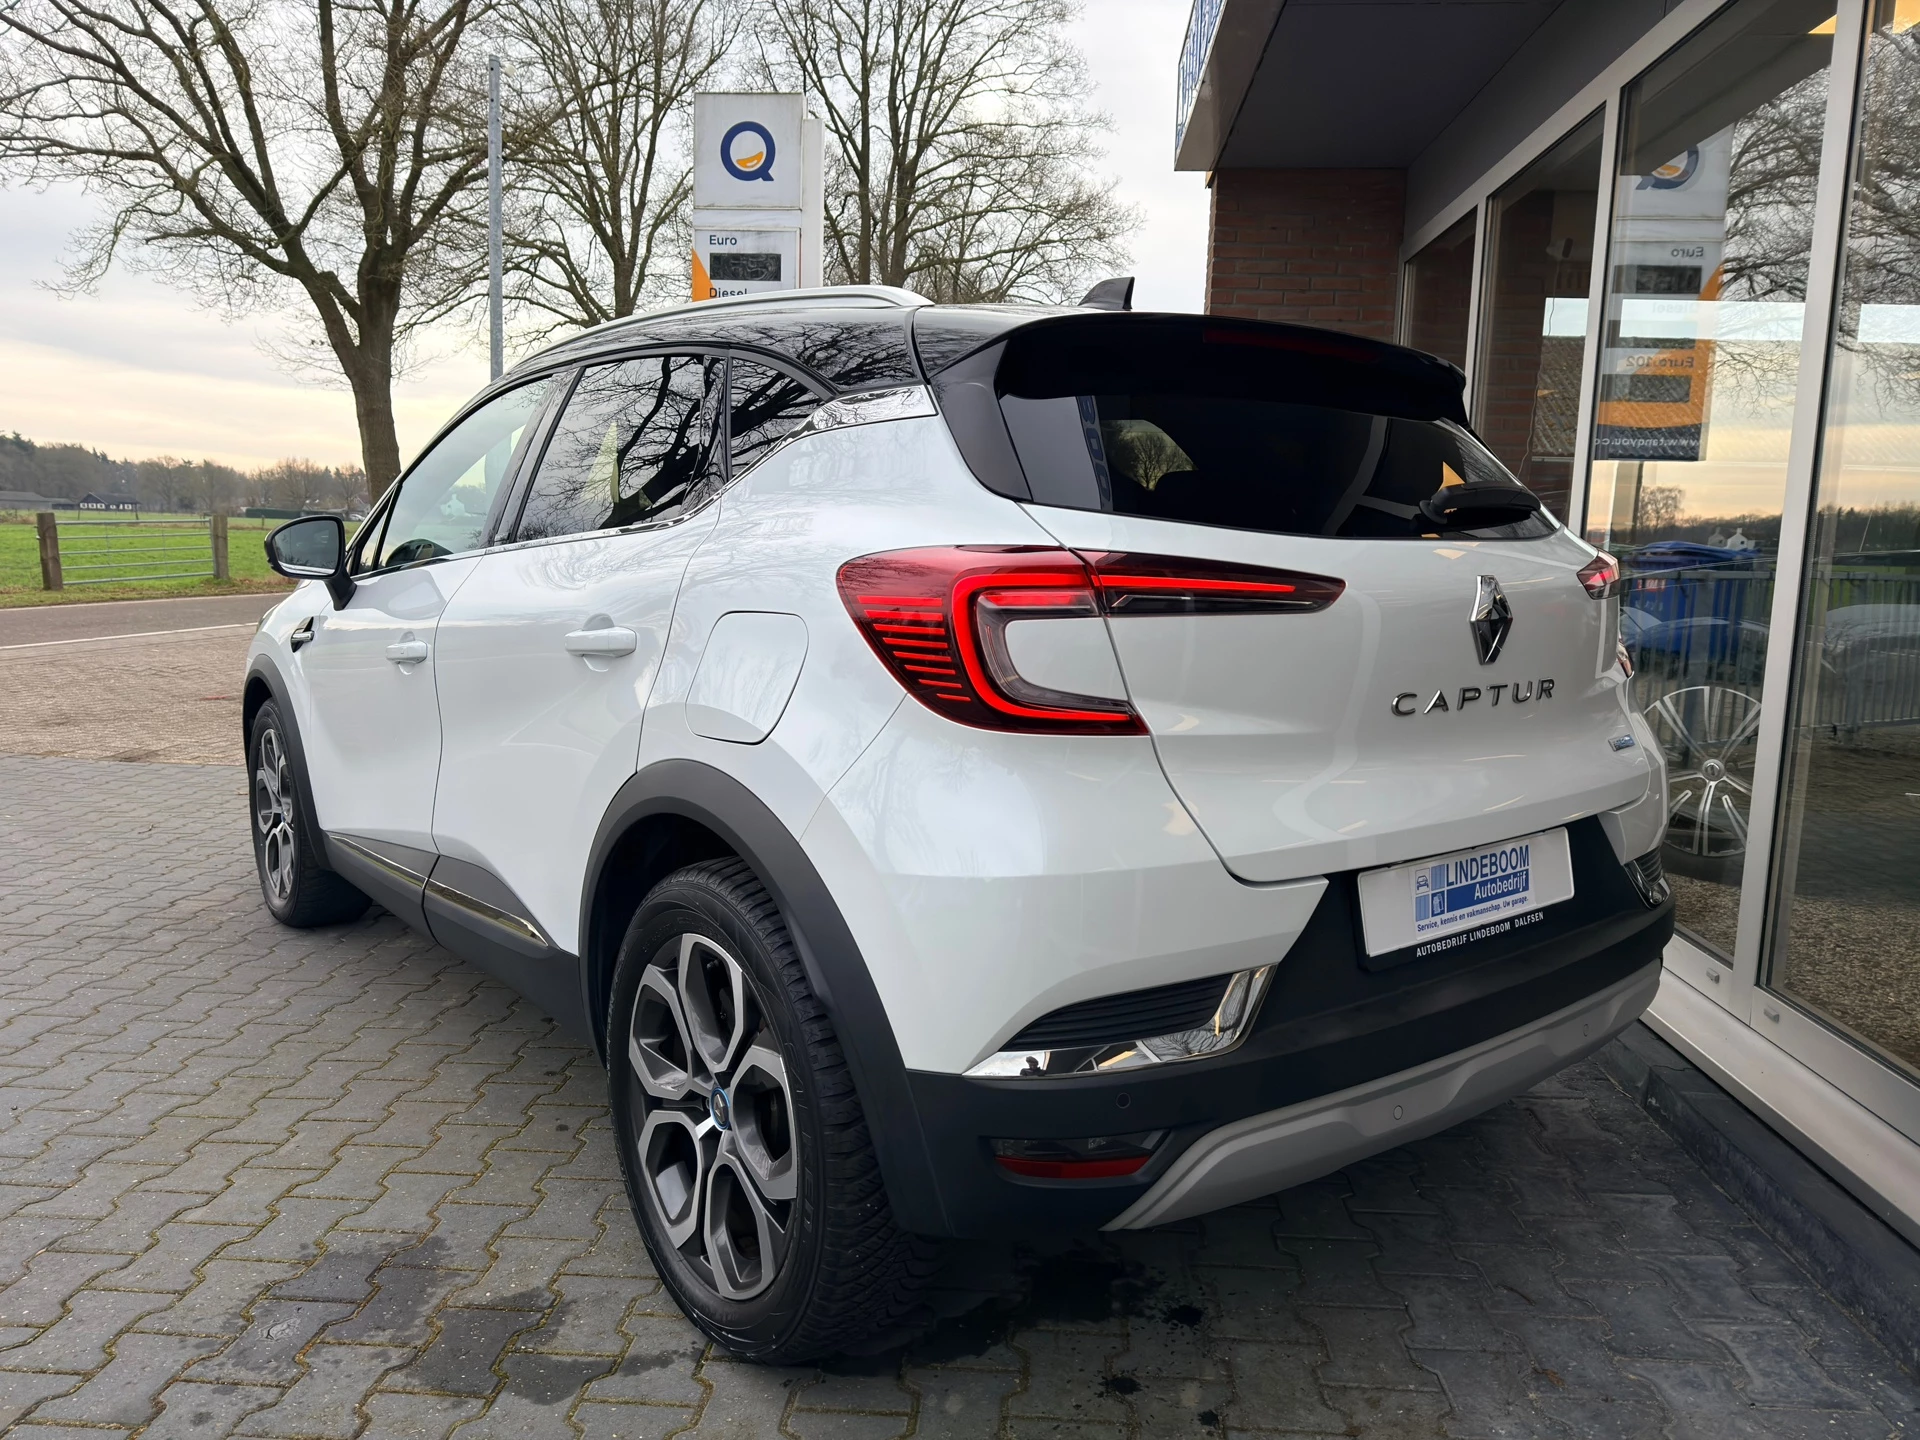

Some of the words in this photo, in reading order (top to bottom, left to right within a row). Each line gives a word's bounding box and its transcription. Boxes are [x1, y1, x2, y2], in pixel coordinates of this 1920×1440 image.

[709, 235, 738, 247] Euro
[1391, 678, 1556, 717] CAPTUR
[1446, 845, 1529, 887] LINDEBOOM
[1474, 871, 1527, 900] Autobedrijf
[1417, 920, 1440, 932] Service,
[1440, 915, 1458, 926] kennis
[1466, 902, 1502, 918] vakmanschap.
[1502, 900, 1511, 908] Uw
[1511, 895, 1529, 907] garage.
[1416, 934, 1468, 957] AUTOBEDRIJF
[1469, 922, 1511, 942] LINDEBOOM
[1514, 911, 1544, 928] DALFSEN
